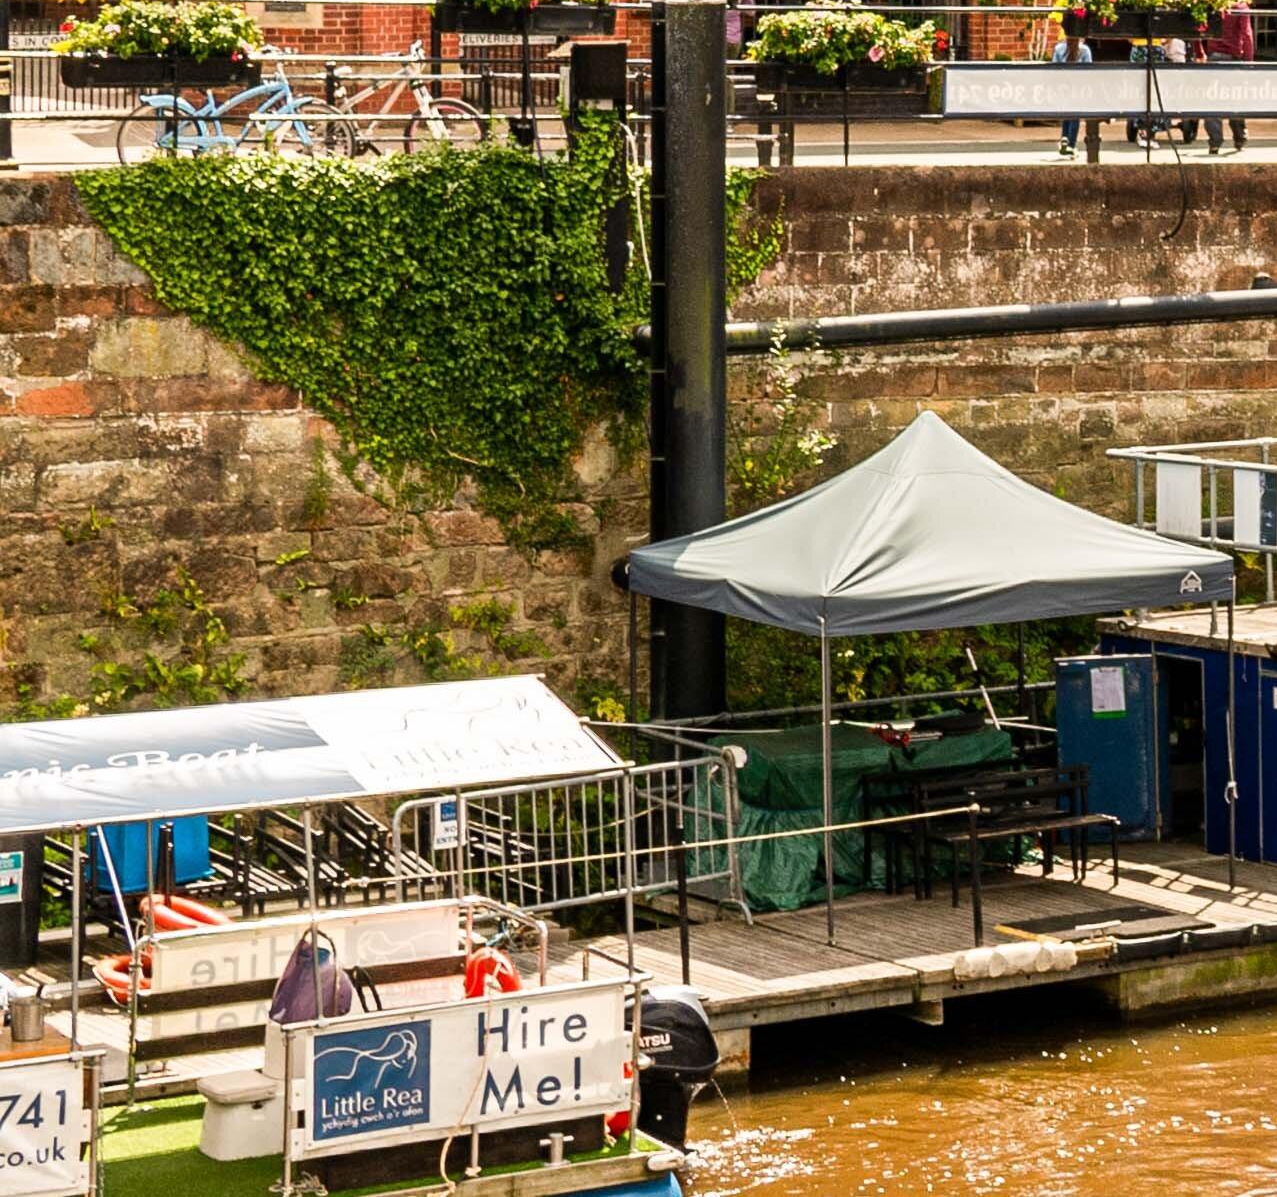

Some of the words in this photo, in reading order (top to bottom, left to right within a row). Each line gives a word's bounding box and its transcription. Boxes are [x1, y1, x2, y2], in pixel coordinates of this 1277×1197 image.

[462, 34, 519, 43] ELIVERIES
[444, 825, 457, 833] NO
[477, 1005, 588, 1056] Hire
[321, 1091, 376, 1118] Little
[383, 1087, 423, 1109] Rea
[479, 1056, 582, 1116] Me!
[0, 1089, 66, 1129] 741
